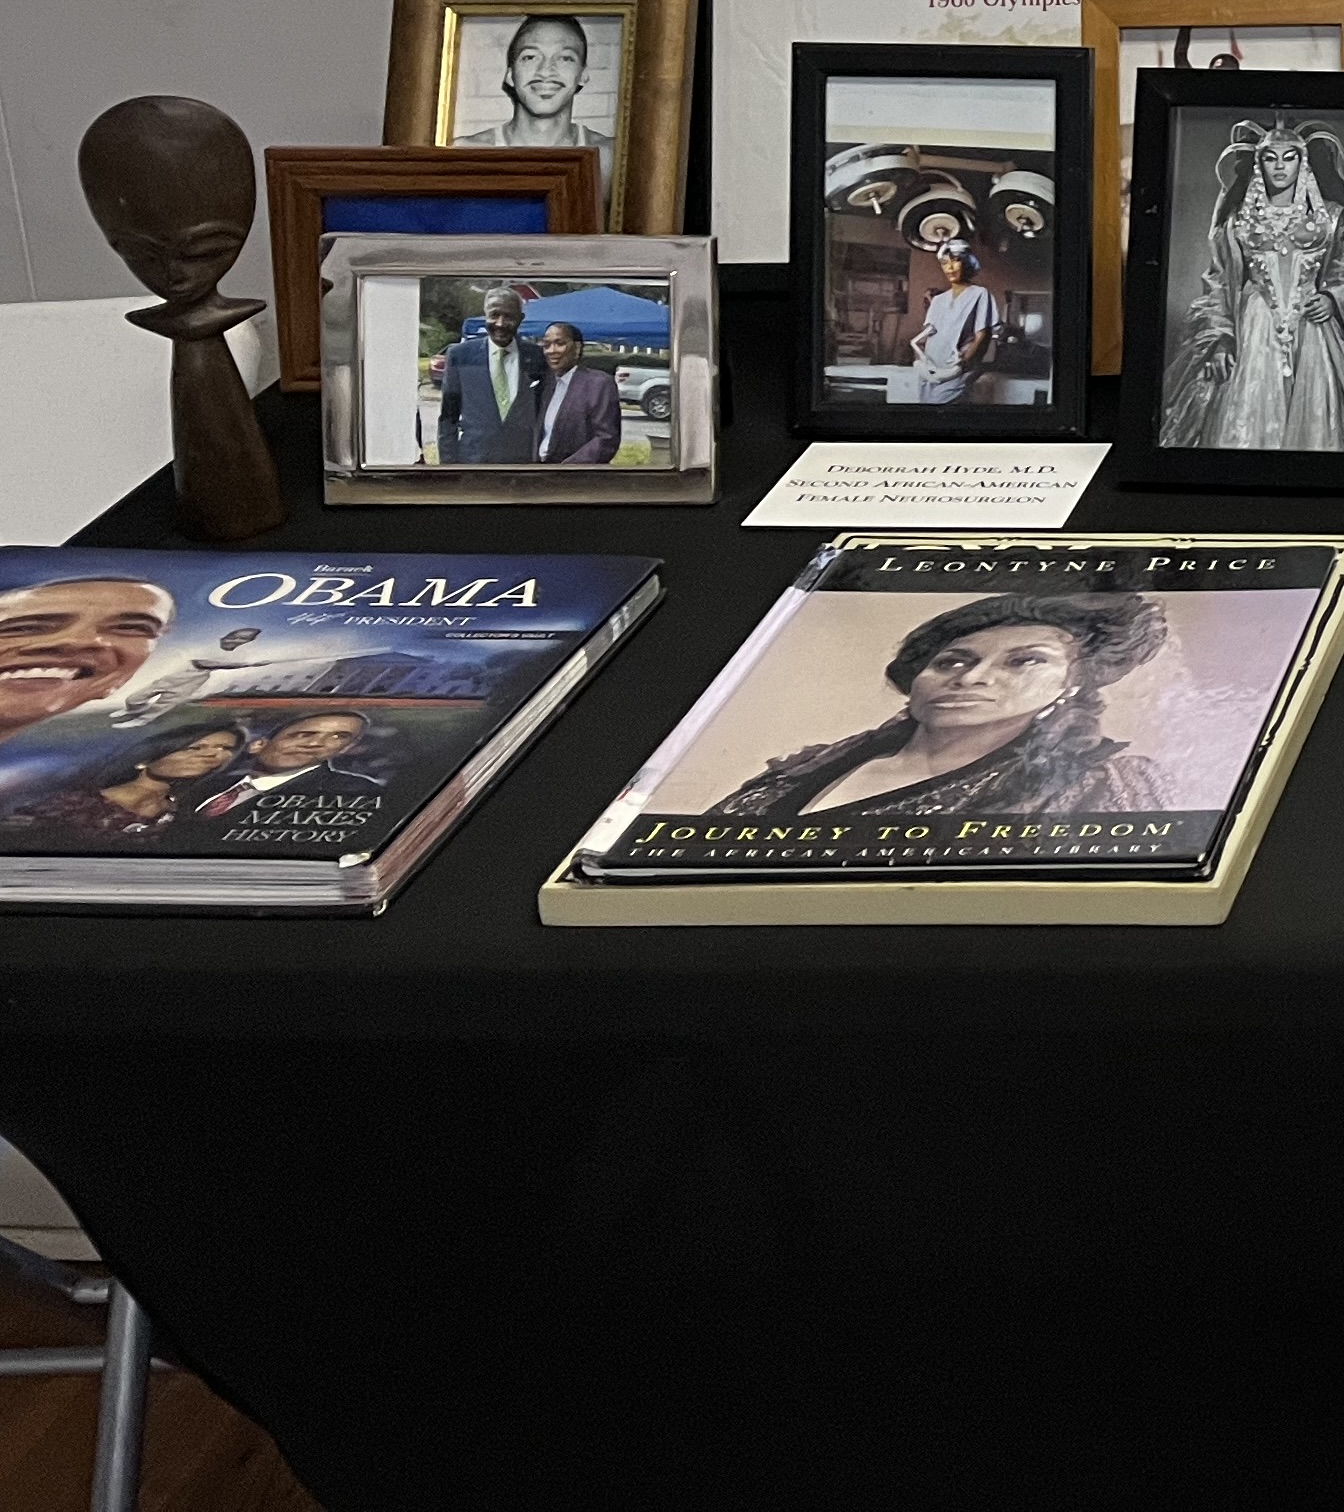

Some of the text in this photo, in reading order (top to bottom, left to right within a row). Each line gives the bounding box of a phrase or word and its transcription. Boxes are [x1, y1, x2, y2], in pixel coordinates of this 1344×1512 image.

[1009, 464, 1058, 475] M.D.
[786, 478, 869, 489] SECOND
[795, 493, 1048, 505] FEMALE NEUROSURGEON
[312, 563, 375, 575] Barack
[877, 556, 1279, 573] LEONTYNE PRICE
[206, 572, 540, 610] OBAMA
[343, 614, 479, 628] PRESIDENT
[255, 794, 382, 810] OBAMA
[238, 809, 374, 826] MAKES
[220, 828, 360, 843] HISTORY
[634, 820, 1173, 844] JOURNEY TO FREEDOM
[628, 843, 1164, 859] THE AFRICAN AMERICAN LIBRARY
